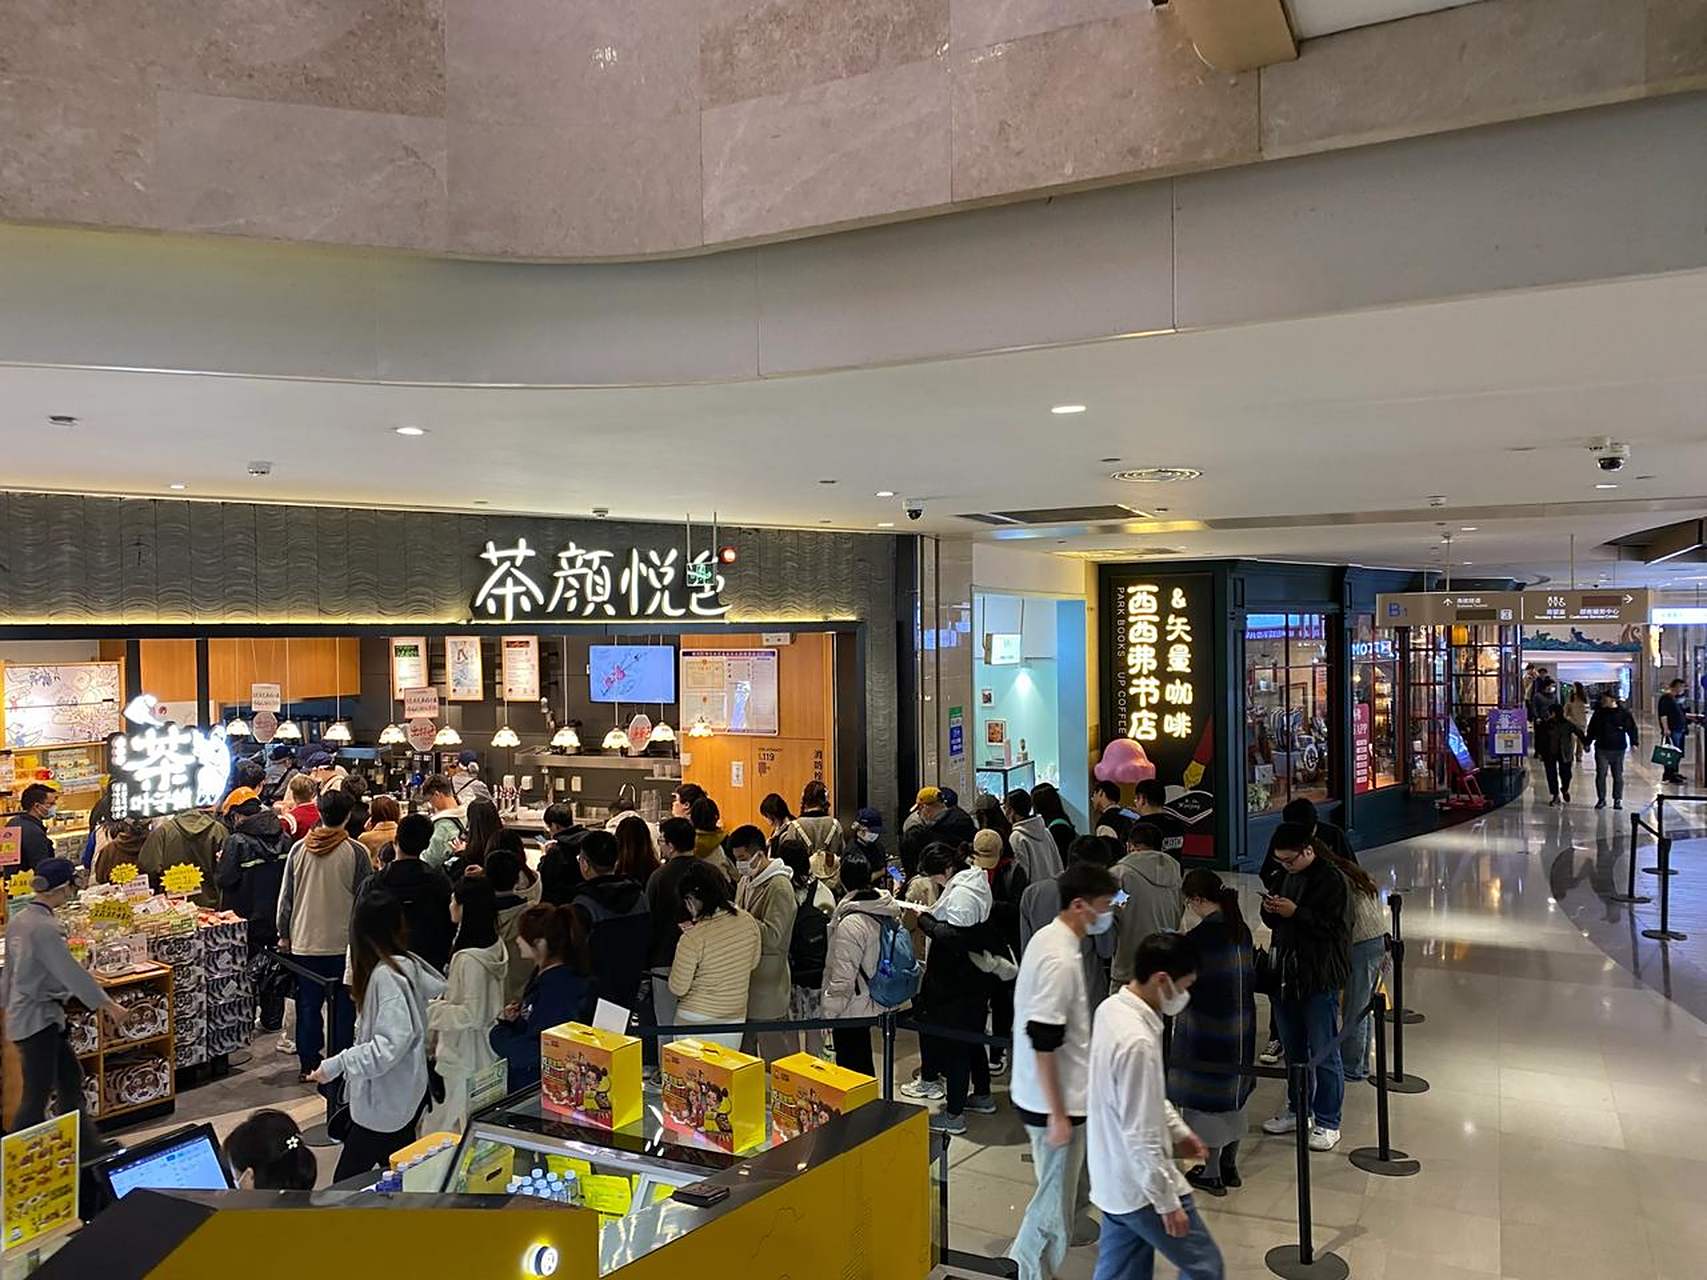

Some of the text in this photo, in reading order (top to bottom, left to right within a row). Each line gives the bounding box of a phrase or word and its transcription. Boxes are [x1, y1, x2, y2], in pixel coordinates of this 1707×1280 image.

[1117, 587, 1127, 735] PARK BOOKS UP COFFEE
[1127, 584, 1161, 741] 西西弗书店
